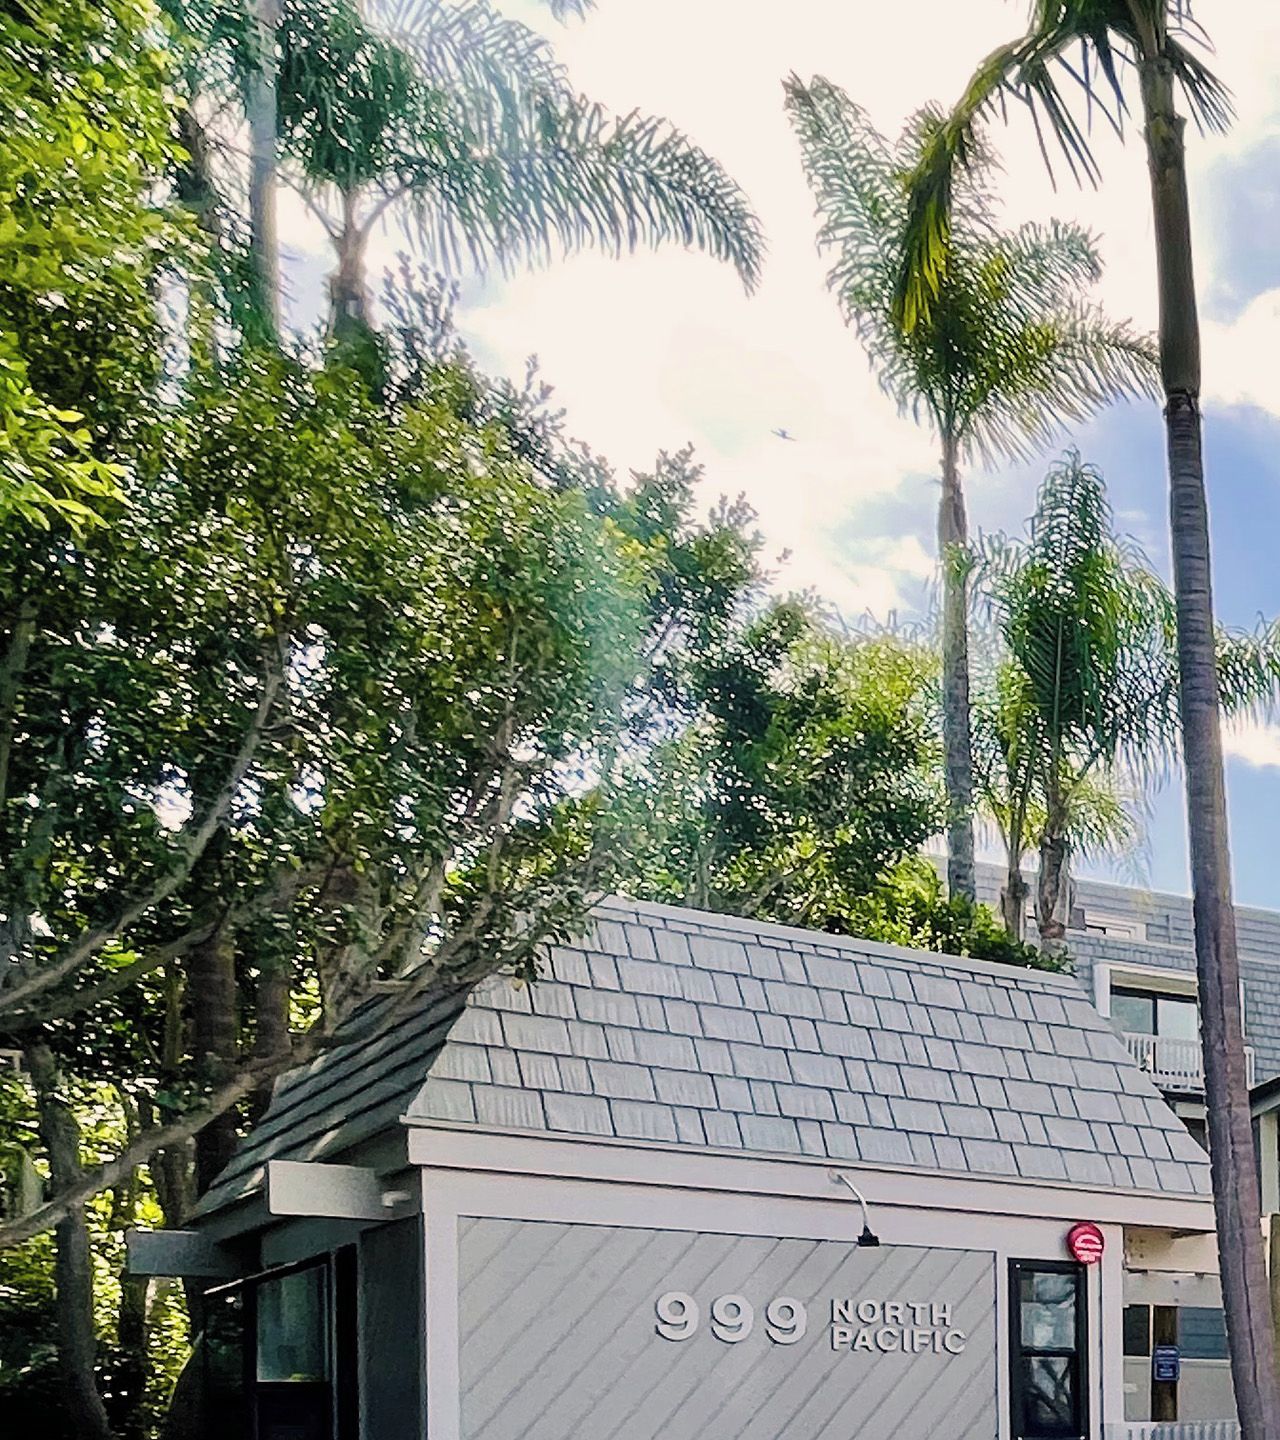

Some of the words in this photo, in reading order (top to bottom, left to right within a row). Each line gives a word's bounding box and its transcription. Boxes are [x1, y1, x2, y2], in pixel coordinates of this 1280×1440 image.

[655, 1291, 808, 1345] 999
[831, 1299, 951, 1326] NORTH
[831, 1325, 967, 1354] PACIFIC
